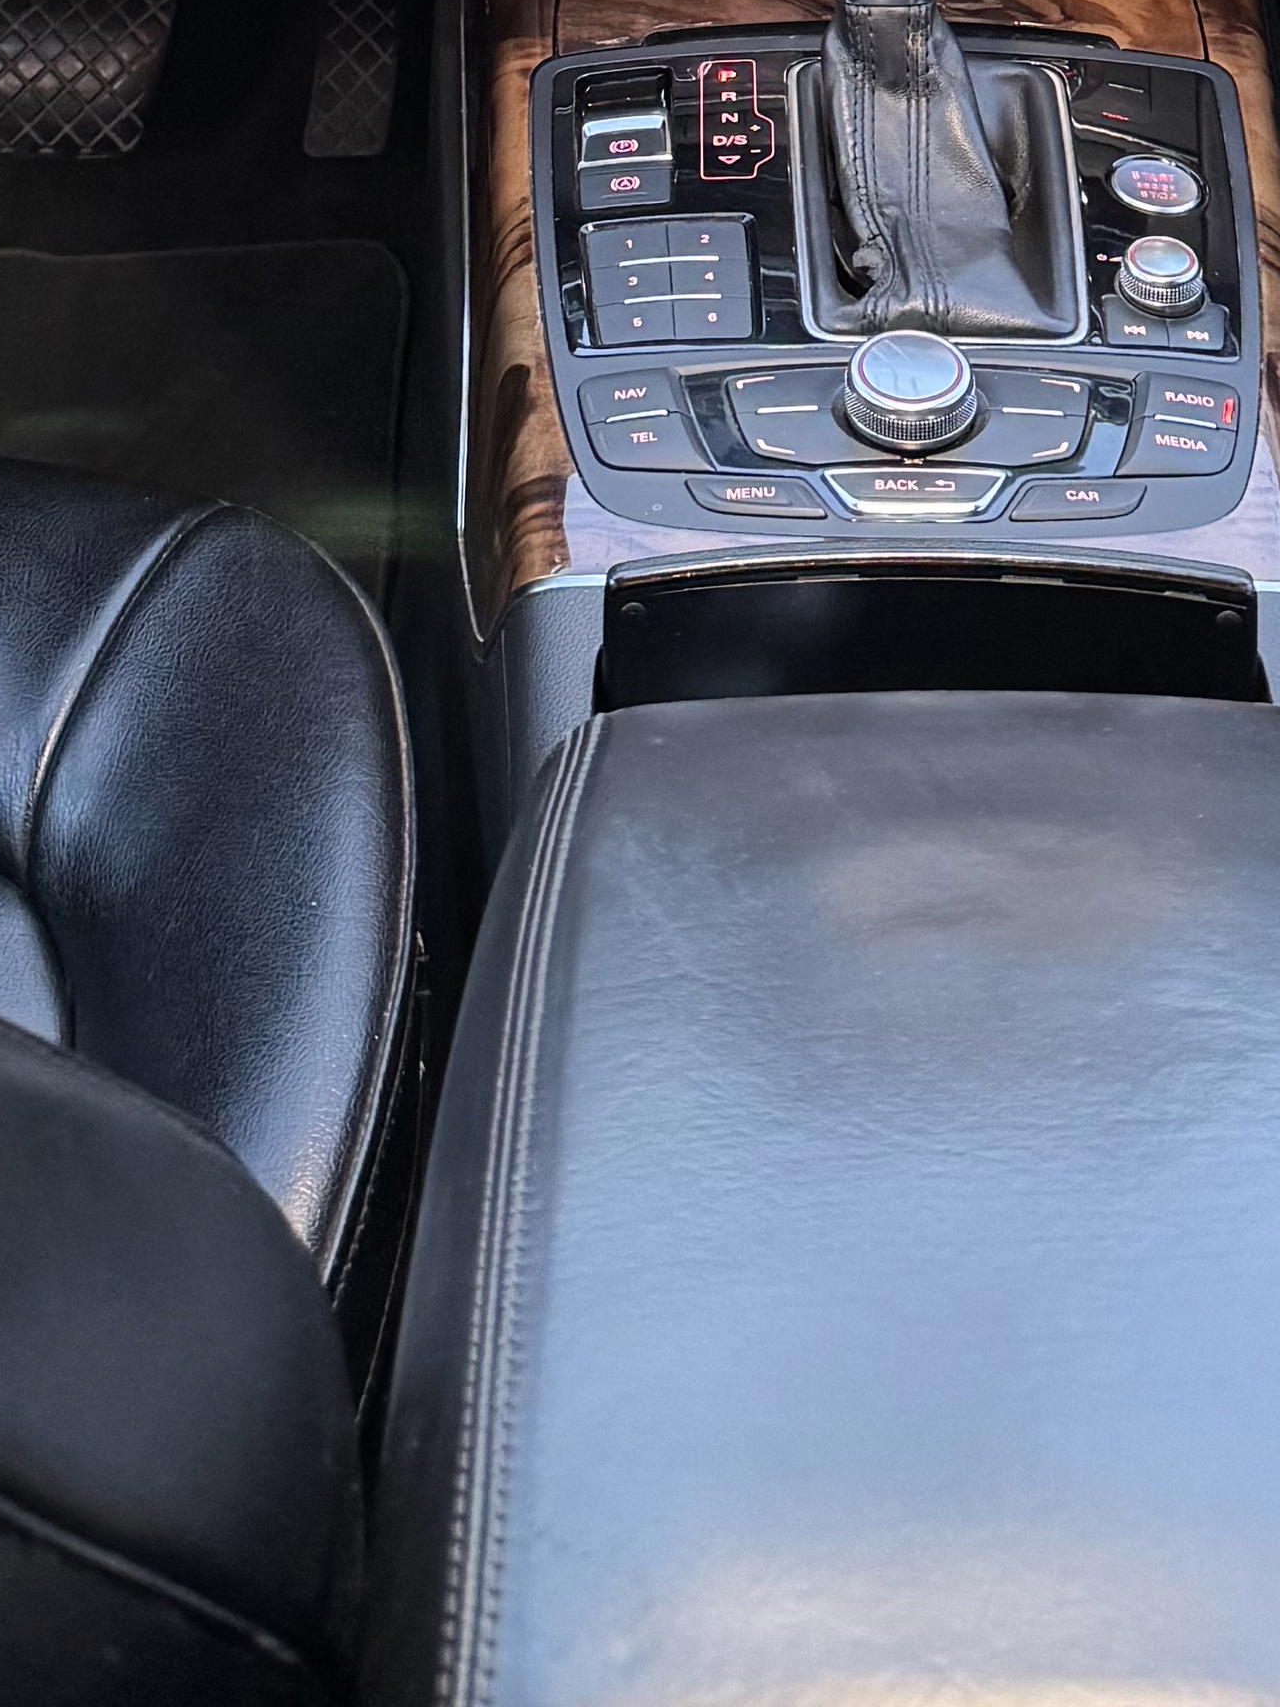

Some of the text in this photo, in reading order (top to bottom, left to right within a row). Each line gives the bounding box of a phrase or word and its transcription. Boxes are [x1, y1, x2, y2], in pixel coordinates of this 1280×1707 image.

[720, 69, 737, 82] P
[721, 91, 737, 101] R
[721, 112, 739, 123] N
[712, 134, 748, 147] D/S
[625, 239, 634, 249] 1
[700, 234, 710, 244] 2
[627, 276, 639, 287] 3
[704, 272, 715, 282] 4
[632, 317, 644, 328] 5
[614, 387, 647, 400] NAV
[1164, 391, 1215, 407] RADIO
[630, 431, 658, 444] TEL
[1154, 434, 1208, 452] MEDIA
[874, 479, 919, 491] BACK
[726, 486, 776, 501] MENU
[1065, 490, 1099, 503] CAR
